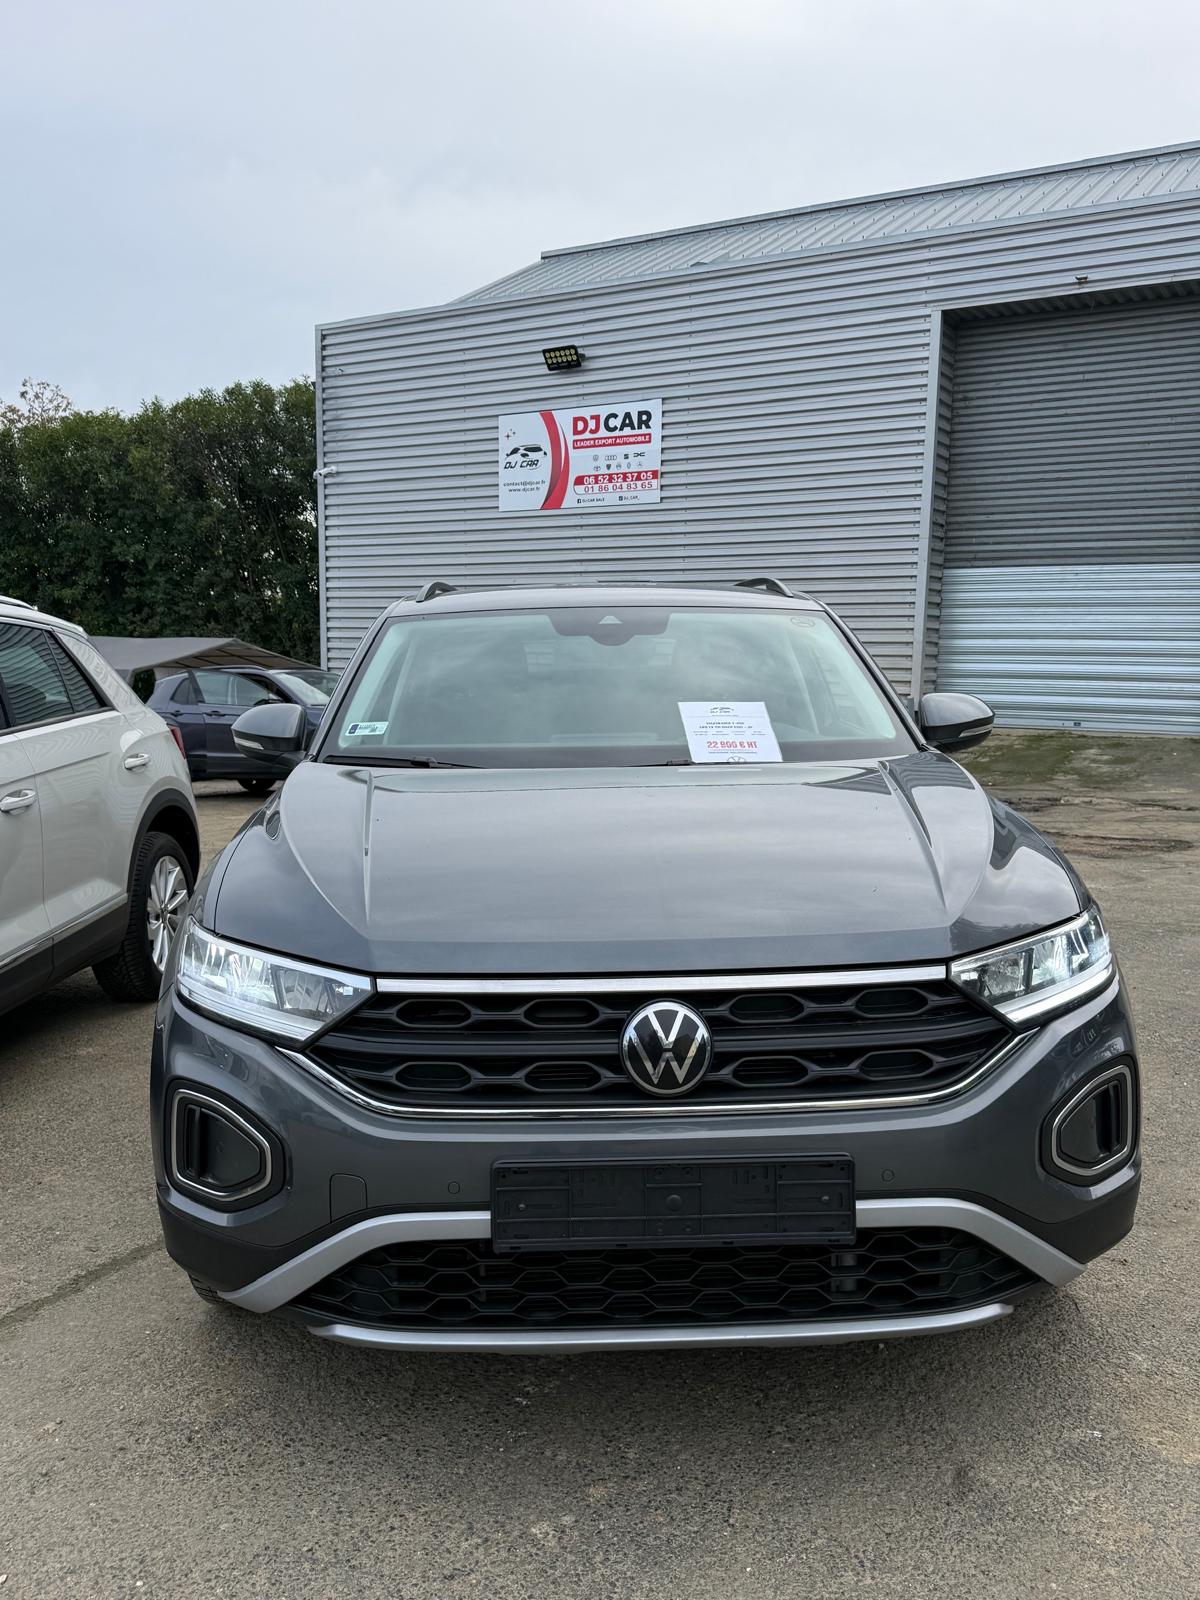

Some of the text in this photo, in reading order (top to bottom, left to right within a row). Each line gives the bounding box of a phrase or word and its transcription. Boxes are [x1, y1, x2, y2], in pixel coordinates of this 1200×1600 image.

[573, 410, 652, 436] DJ CAR
[574, 435, 650, 448] LEADER EXPORT AUTOMOBILE
[503, 459, 539, 469] DJ CAR
[583, 471, 653, 485] 06 52 32 37 05
[584, 481, 653, 493] 01 86 04 83 65
